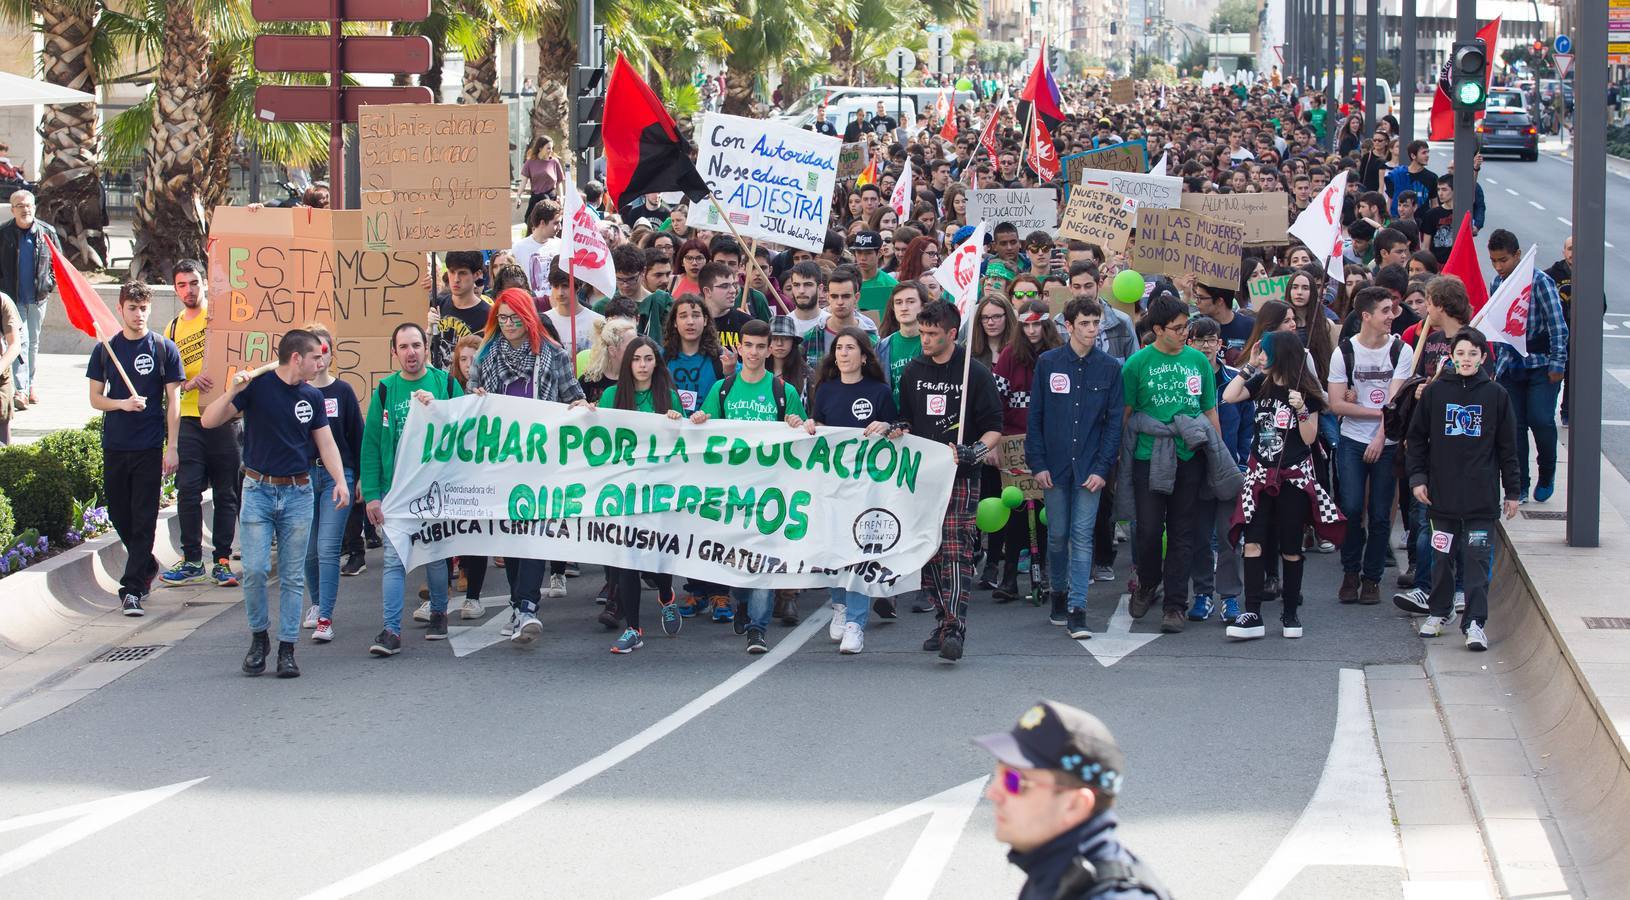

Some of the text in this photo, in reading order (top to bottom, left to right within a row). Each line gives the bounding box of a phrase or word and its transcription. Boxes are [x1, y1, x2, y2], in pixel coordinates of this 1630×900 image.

[711, 125, 745, 149] Con
[751, 134, 835, 171] Autoridad
[751, 166, 803, 191] educa
[1111, 177, 1170, 199] RECORTES
[727, 183, 823, 224] ADIESTRA
[976, 191, 1030, 205] POR UNA
[1069, 199, 1127, 218] FUTURO NO
[1072, 187, 1121, 206] NUESTRO
[366, 212, 388, 242] NO
[1066, 208, 1129, 231] ES VUESTRO
[1144, 213, 1160, 224] NI
[1167, 215, 1191, 229] LAS
[1141, 228, 1243, 257] NI LA EDUCACIÓN
[228, 247, 420, 290] ESTAMOS
[1138, 245, 1240, 282] SOMOS MERCANCÍA
[230, 286, 405, 324] BASTANTE
[226, 331, 361, 370] HARS
[421, 415, 548, 464] LUCHAR
[559, 425, 638, 467] POR
[649, 434, 689, 463] LA
[508, 481, 812, 540] QUE QUEREMOS
[859, 519, 895, 530] FRENTE
[411, 520, 482, 546] PÚBLICA
[588, 521, 679, 555] INCLUSIVA
[698, 539, 788, 574] GRATUITA
